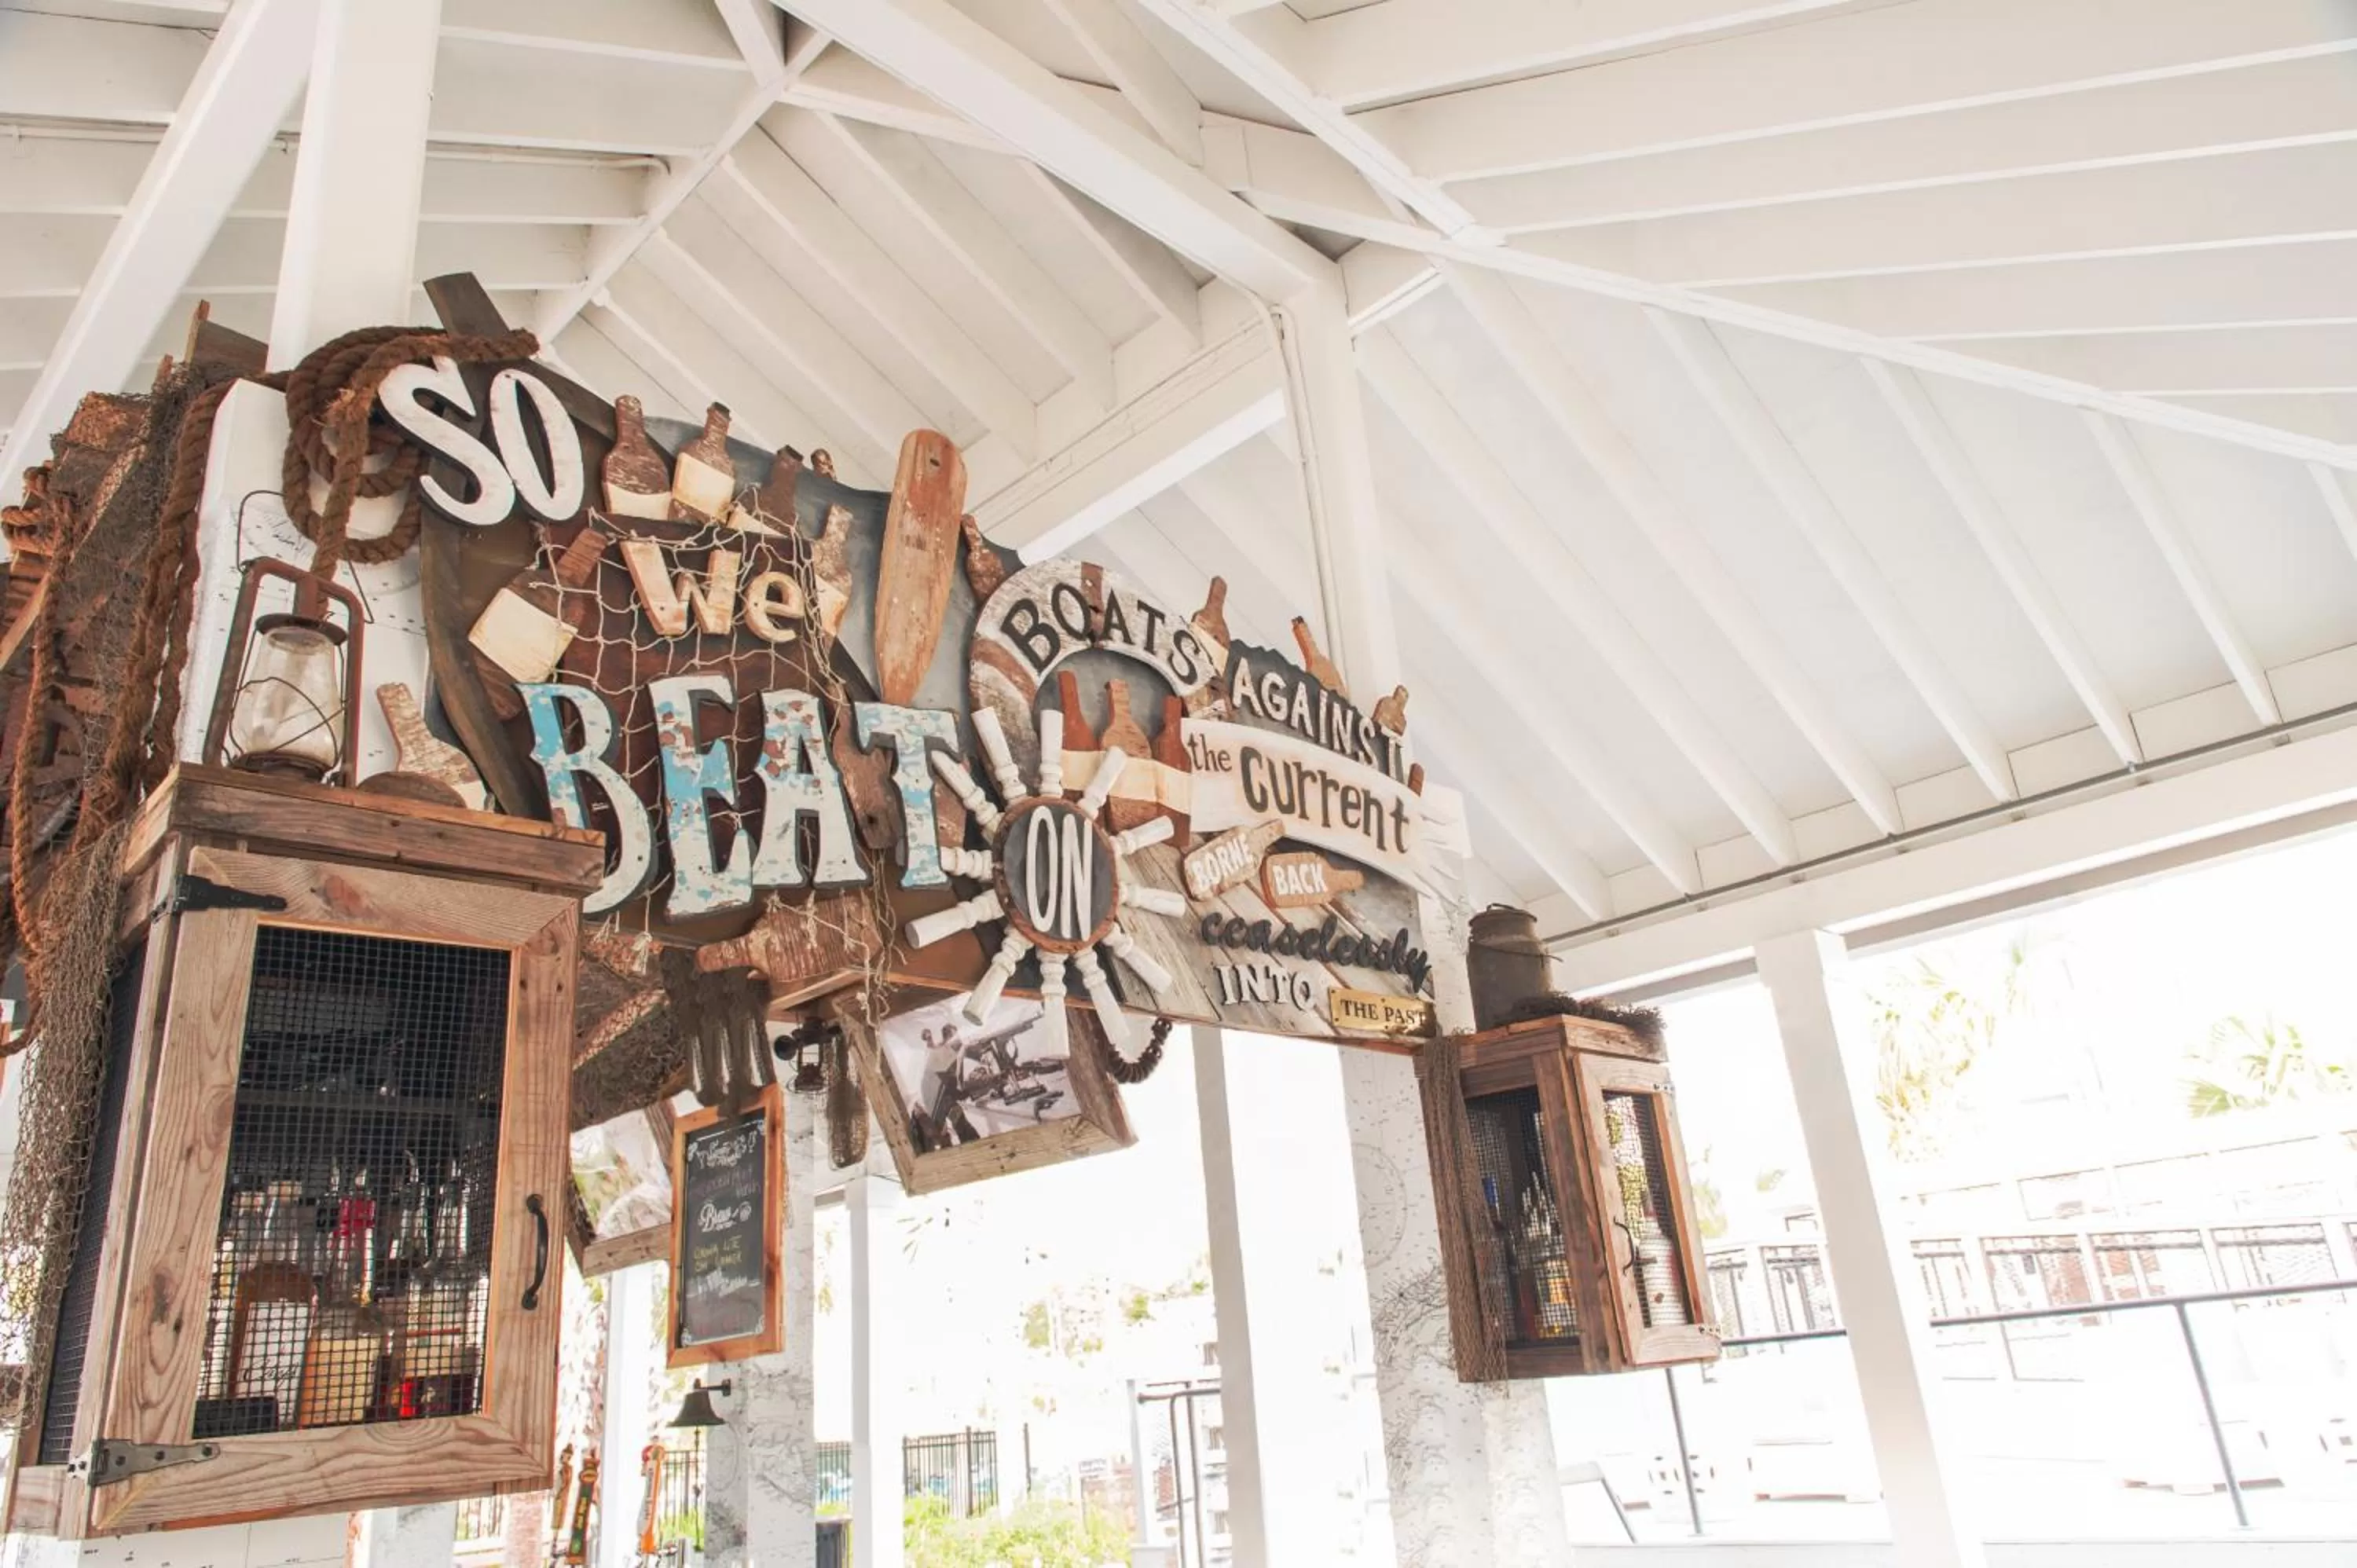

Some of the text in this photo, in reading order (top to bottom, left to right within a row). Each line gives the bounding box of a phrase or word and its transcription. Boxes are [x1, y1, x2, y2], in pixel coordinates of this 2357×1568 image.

[379, 355, 584, 526] SO
[619, 539, 805, 643] We
[1001, 583, 1200, 686] BOATS
[1186, 731, 1233, 773] the
[1232, 657, 1405, 781] AGAINST
[516, 673, 960, 918] BEAT
[1026, 805, 1093, 942] ON
[1190, 833, 1255, 892] BORNE
[1272, 863, 1329, 896] BACK
[1215, 964, 1318, 1013] INTO
[1340, 999, 1427, 1027] THE PAST
